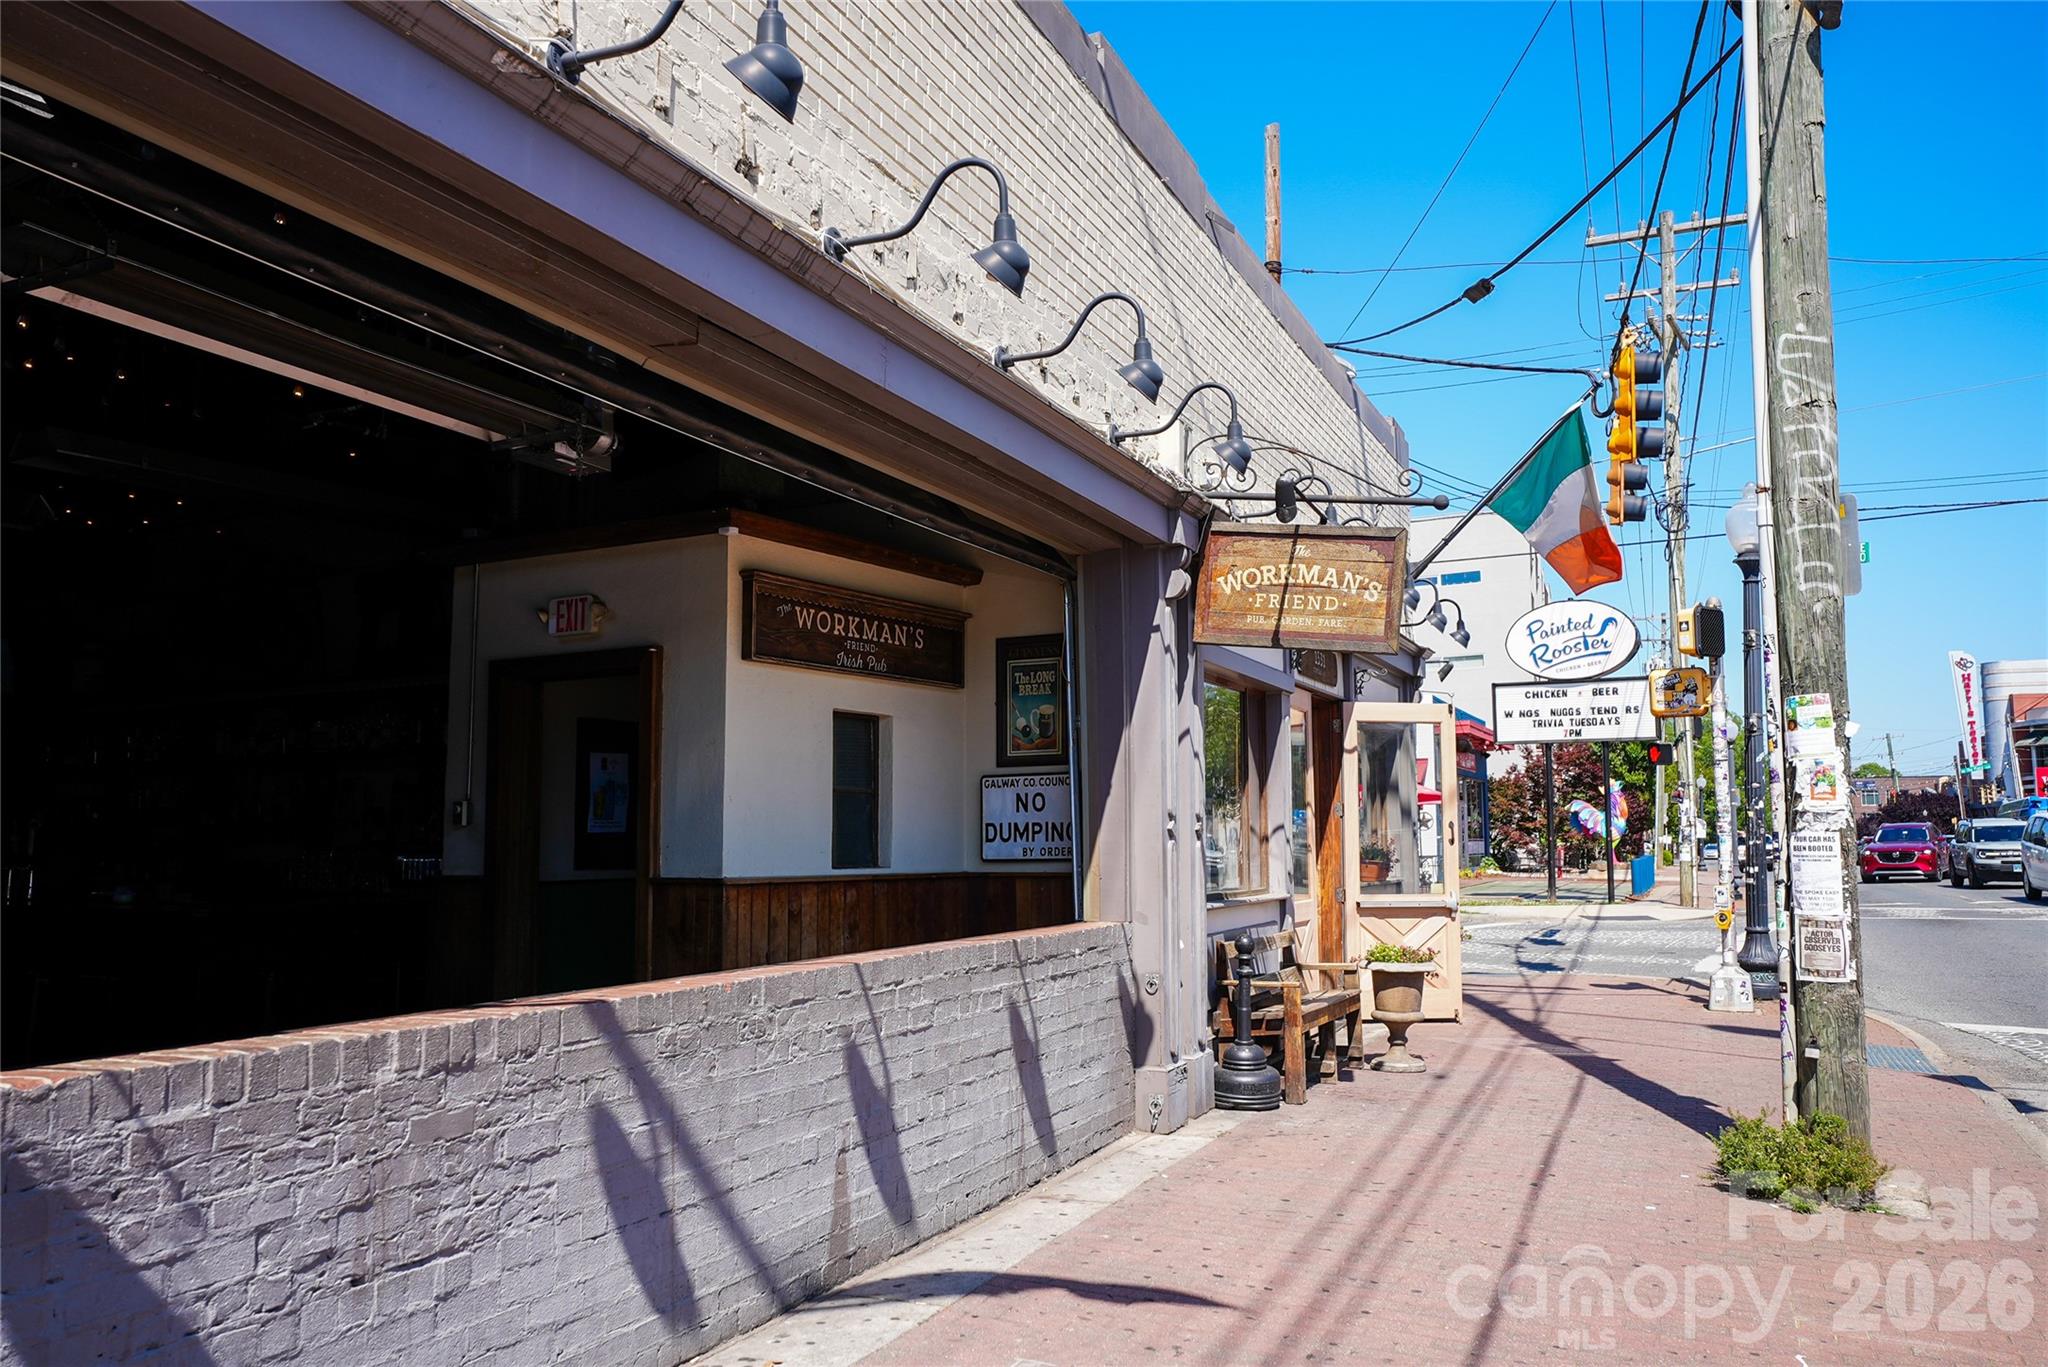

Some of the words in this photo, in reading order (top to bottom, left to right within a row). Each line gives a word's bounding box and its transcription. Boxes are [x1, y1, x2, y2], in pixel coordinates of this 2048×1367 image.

[1294, 545, 1311, 558] The
[1216, 564, 1383, 602] WORKMAN'S
[1254, 593, 1339, 610] FRIEND
[556, 597, 588, 632] EXIT
[777, 603, 793, 617] The
[795, 606, 924, 649] WORKMAN'S
[1247, 615, 1267, 624] PUB.
[1318, 619, 1346, 628] FARE.
[1526, 613, 1595, 644] Painted
[847, 640, 876, 653] FRIEND
[1529, 632, 1612, 668] Rooster
[836, 652, 863, 669] Irish
[867, 655, 887, 672] Pub
[1014, 672, 1029, 684] The
[1029, 670, 1056, 684] LONG
[1018, 684, 1051, 696] BREAK
[1524, 689, 1568, 699] CHICKEN
[1592, 687, 1619, 696] BEER
[1961, 673, 1974, 718] Harris
[1550, 707, 1581, 717] NUGGS
[1532, 719, 1564, 728] TRIVIA
[1569, 717, 1621, 727] TUESDAYS
[1563, 728, 1582, 737] 7PM
[984, 778, 1020, 789] GALWAY
[1023, 777, 1038, 787] CO.
[1015, 792, 1046, 813] NO
[1022, 848, 1034, 857] BY
[1040, 847, 1072, 857] ORDER
